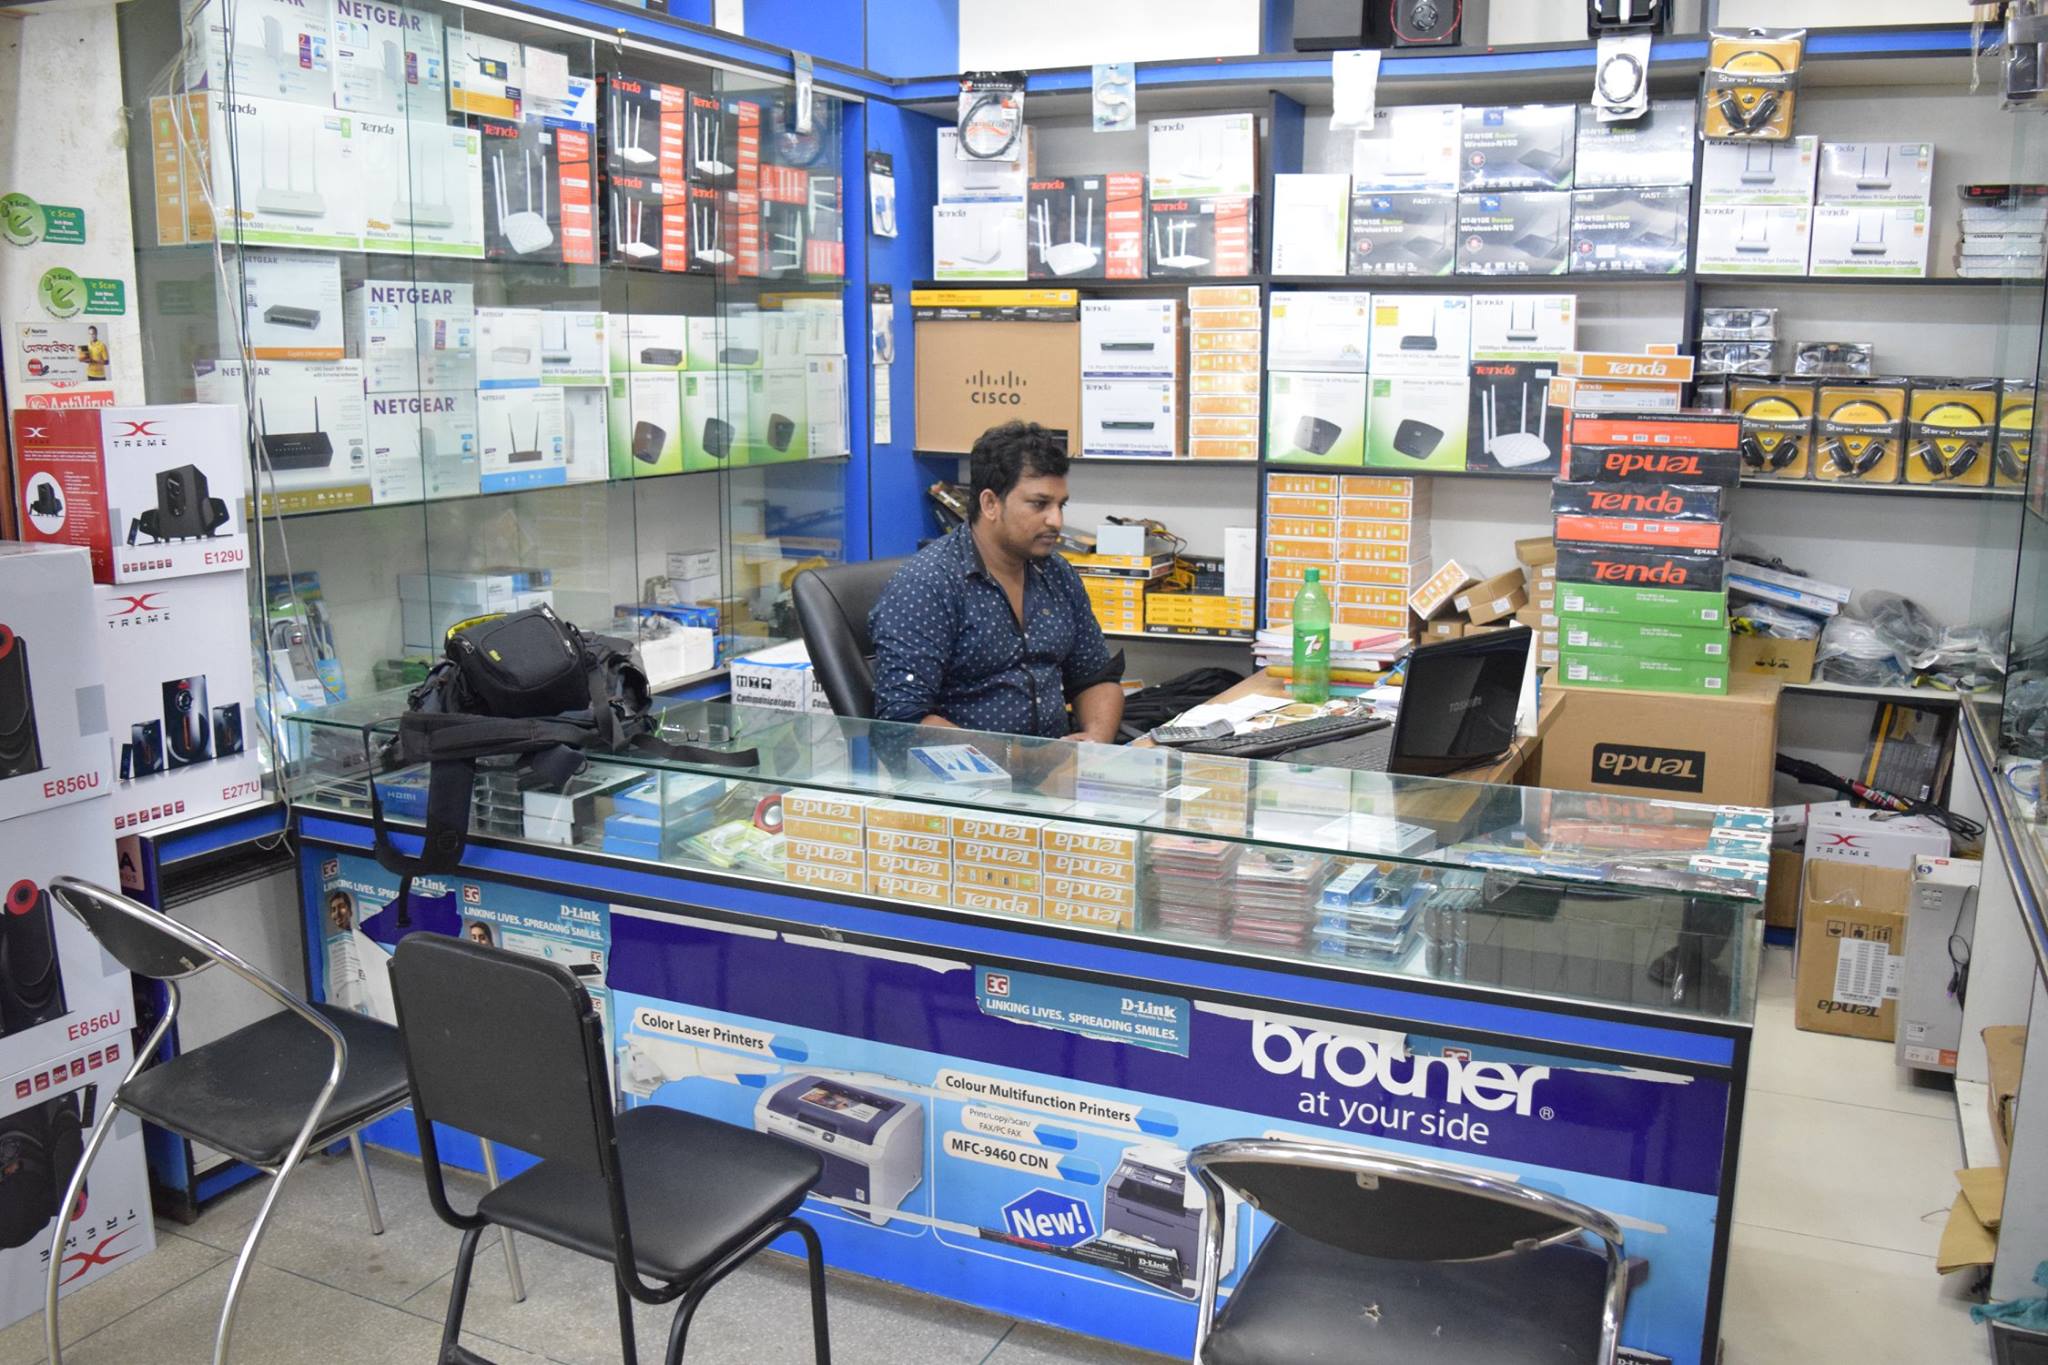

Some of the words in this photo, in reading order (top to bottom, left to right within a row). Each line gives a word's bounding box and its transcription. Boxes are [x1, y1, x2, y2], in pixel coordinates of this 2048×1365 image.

[338, 1, 421, 31] NETGEAR
[361, 121, 395, 135] Tenda
[483, 123, 519, 138] Tenda
[371, 287, 453, 304] NETGEAR
[1474, 364, 1516, 376] Tenda
[1606, 360, 1667, 376] Tenda
[373, 397, 455, 415] NETGEAR
[971, 391, 1021, 405] CISCO
[1605, 452, 1703, 476] Tenda
[1587, 489, 1684, 513] Tenda
[204, 550, 244, 565] E129U
[1592, 560, 1688, 585] Tenda
[1598, 751, 1698, 780] Tenda
[43, 772, 99, 799] E856U
[222, 781, 260, 801] E277U
[792, 799, 855, 819] Tenda
[963, 821, 1031, 842] Tenda
[795, 843, 857, 864] Tenda
[878, 833, 943, 855] Tenda
[965, 844, 1033, 865] Tenda
[1055, 833, 1126, 855] Tenda
[795, 865, 857, 886] Tenda
[878, 855, 943, 876] Tenda
[1055, 856, 1126, 878] Tenda
[464, 885, 480, 903] 3G
[878, 877, 943, 898] Tenda
[1055, 880, 1126, 902] Tenda
[560, 904, 600, 922] D-Link
[961, 891, 1030, 914] Tenda
[1055, 902, 1125, 925] Tenda
[464, 906, 497, 921] LINKING
[497, 912, 522, 926] LIVES.
[523, 917, 571, 935] SPREADING
[987, 973, 1009, 995] 3G
[1120, 997, 1177, 1019] D-Link
[1817, 999, 1880, 1017] Tenda
[67, 1009, 122, 1041] E856U
[986, 998, 1030, 1015] LINKING
[1032, 1006, 1065, 1022] LIVES.
[1068, 1012, 1133, 1033] SPREADING
[1134, 1023, 1179, 1041] SMILES.
[641, 1013, 674, 1031] Color
[677, 1020, 710, 1038] Laser
[713, 1027, 764, 1049] Printers
[945, 1075, 986, 1094] Colour
[989, 1084, 1076, 1112] Multifunction
[1079, 1102, 1131, 1122] Printers
[1298, 1091, 1330, 1116] at
[1339, 1098, 1415, 1132] your
[1420, 1109, 1489, 1145] side
[979, 1122, 1007, 1136] FAX/PC
[1007, 1128, 1022, 1138] FAX
[952, 1138, 1017, 1163] MFC-9460
[1019, 1153, 1049, 1170] CDN
[1011, 1203, 1087, 1239] New!
[1138, 1258, 1171, 1271] D-Link
